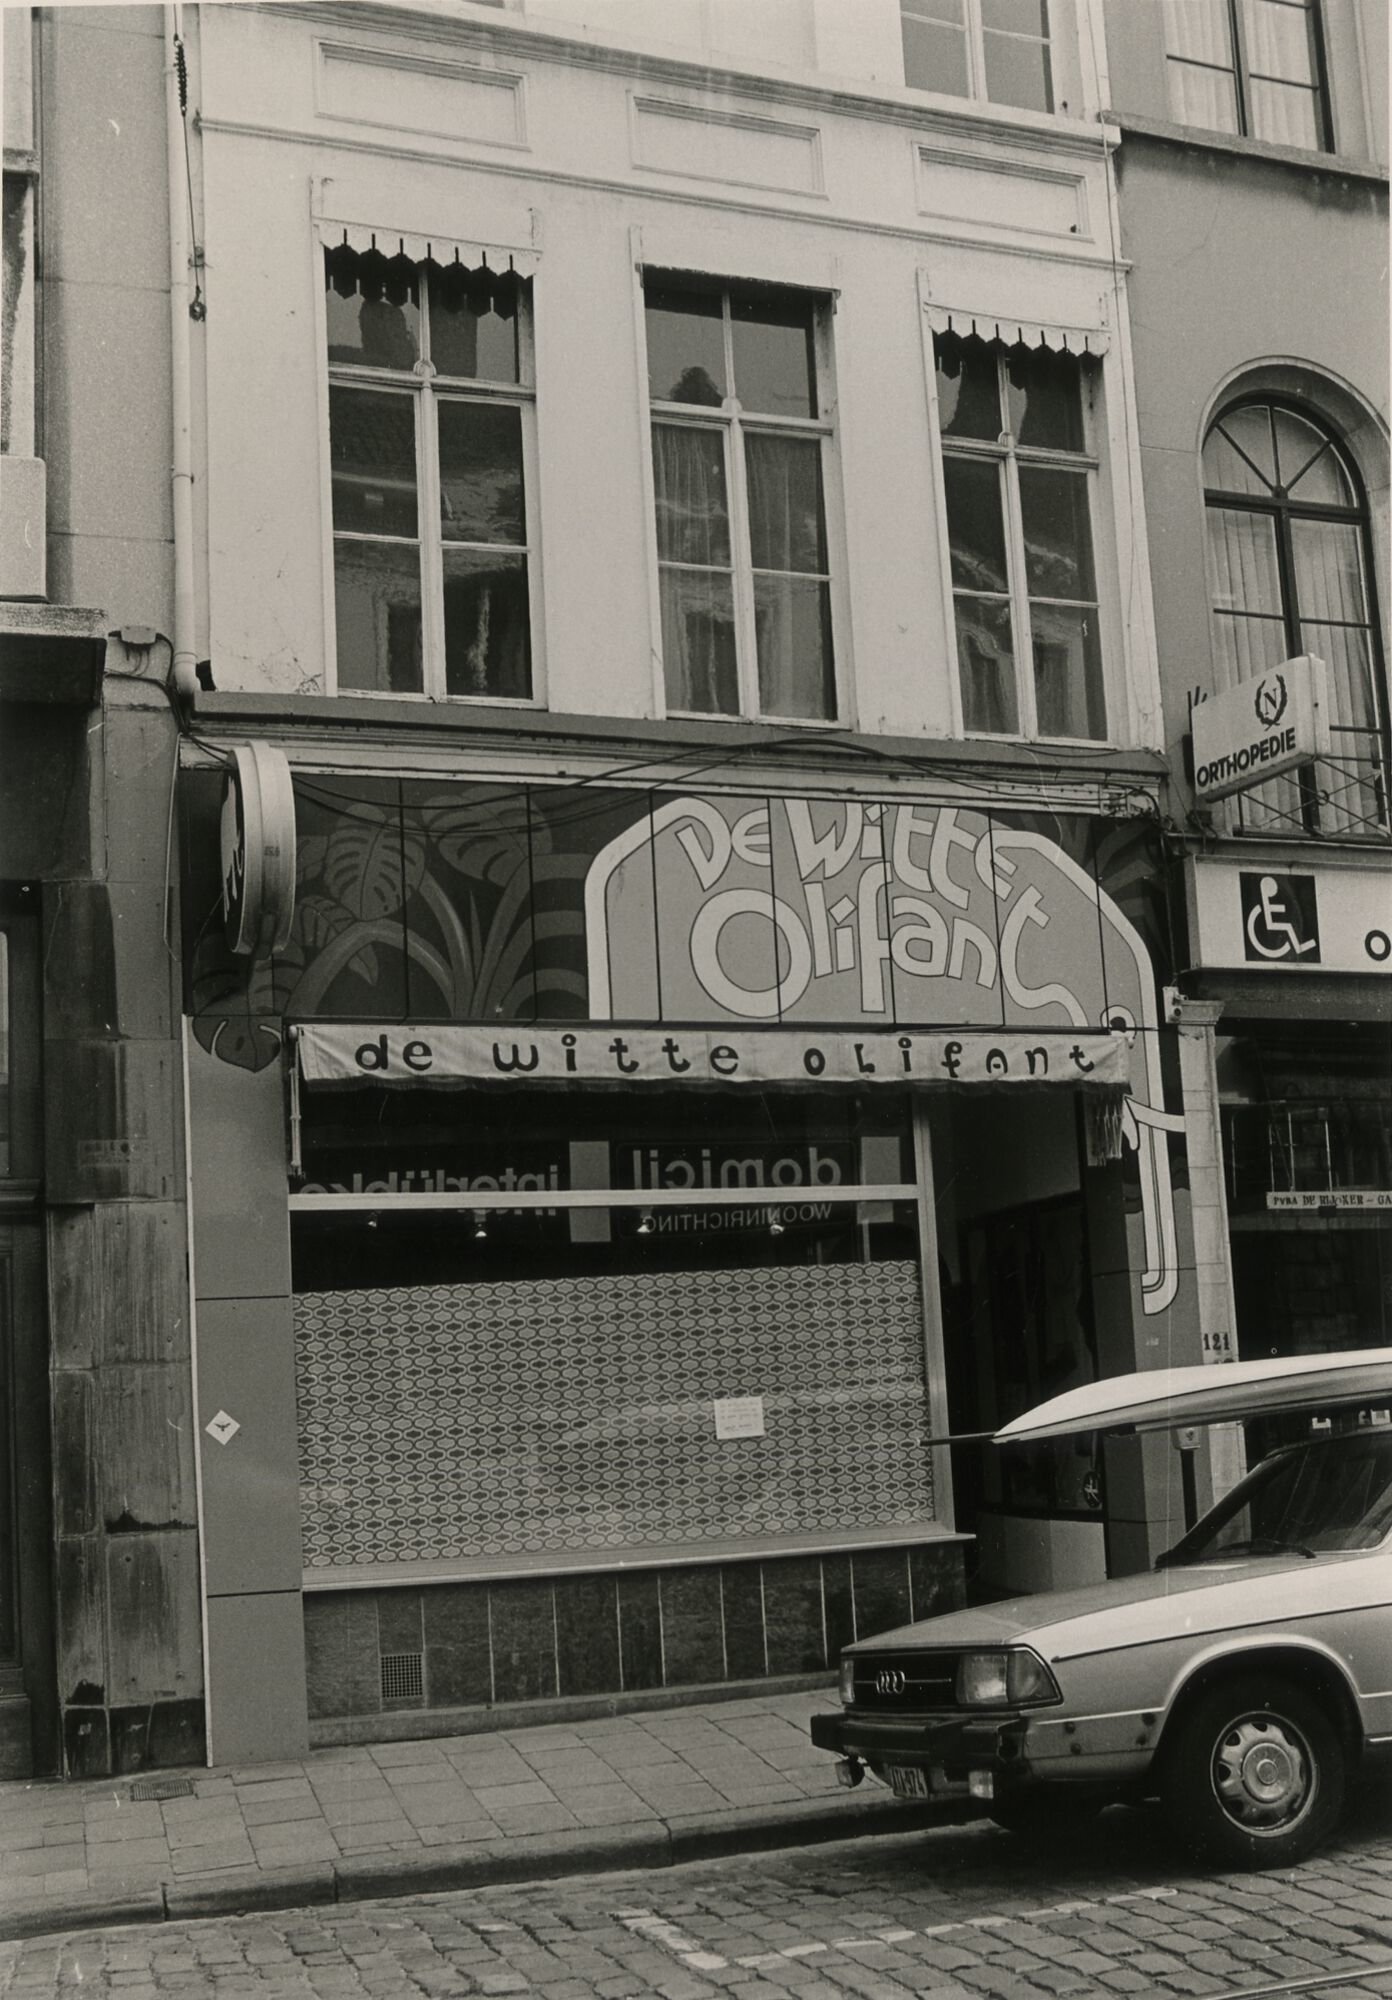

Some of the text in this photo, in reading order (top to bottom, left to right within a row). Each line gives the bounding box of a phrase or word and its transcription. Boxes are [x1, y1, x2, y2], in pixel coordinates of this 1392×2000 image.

[1263, 688, 1280, 717] N
[1196, 727, 1297, 788] ORTHOPEDIE
[354, 1033, 434, 1073] de
[492, 1032, 740, 1075] witte
[1203, 1332, 1230, 1351] 121
